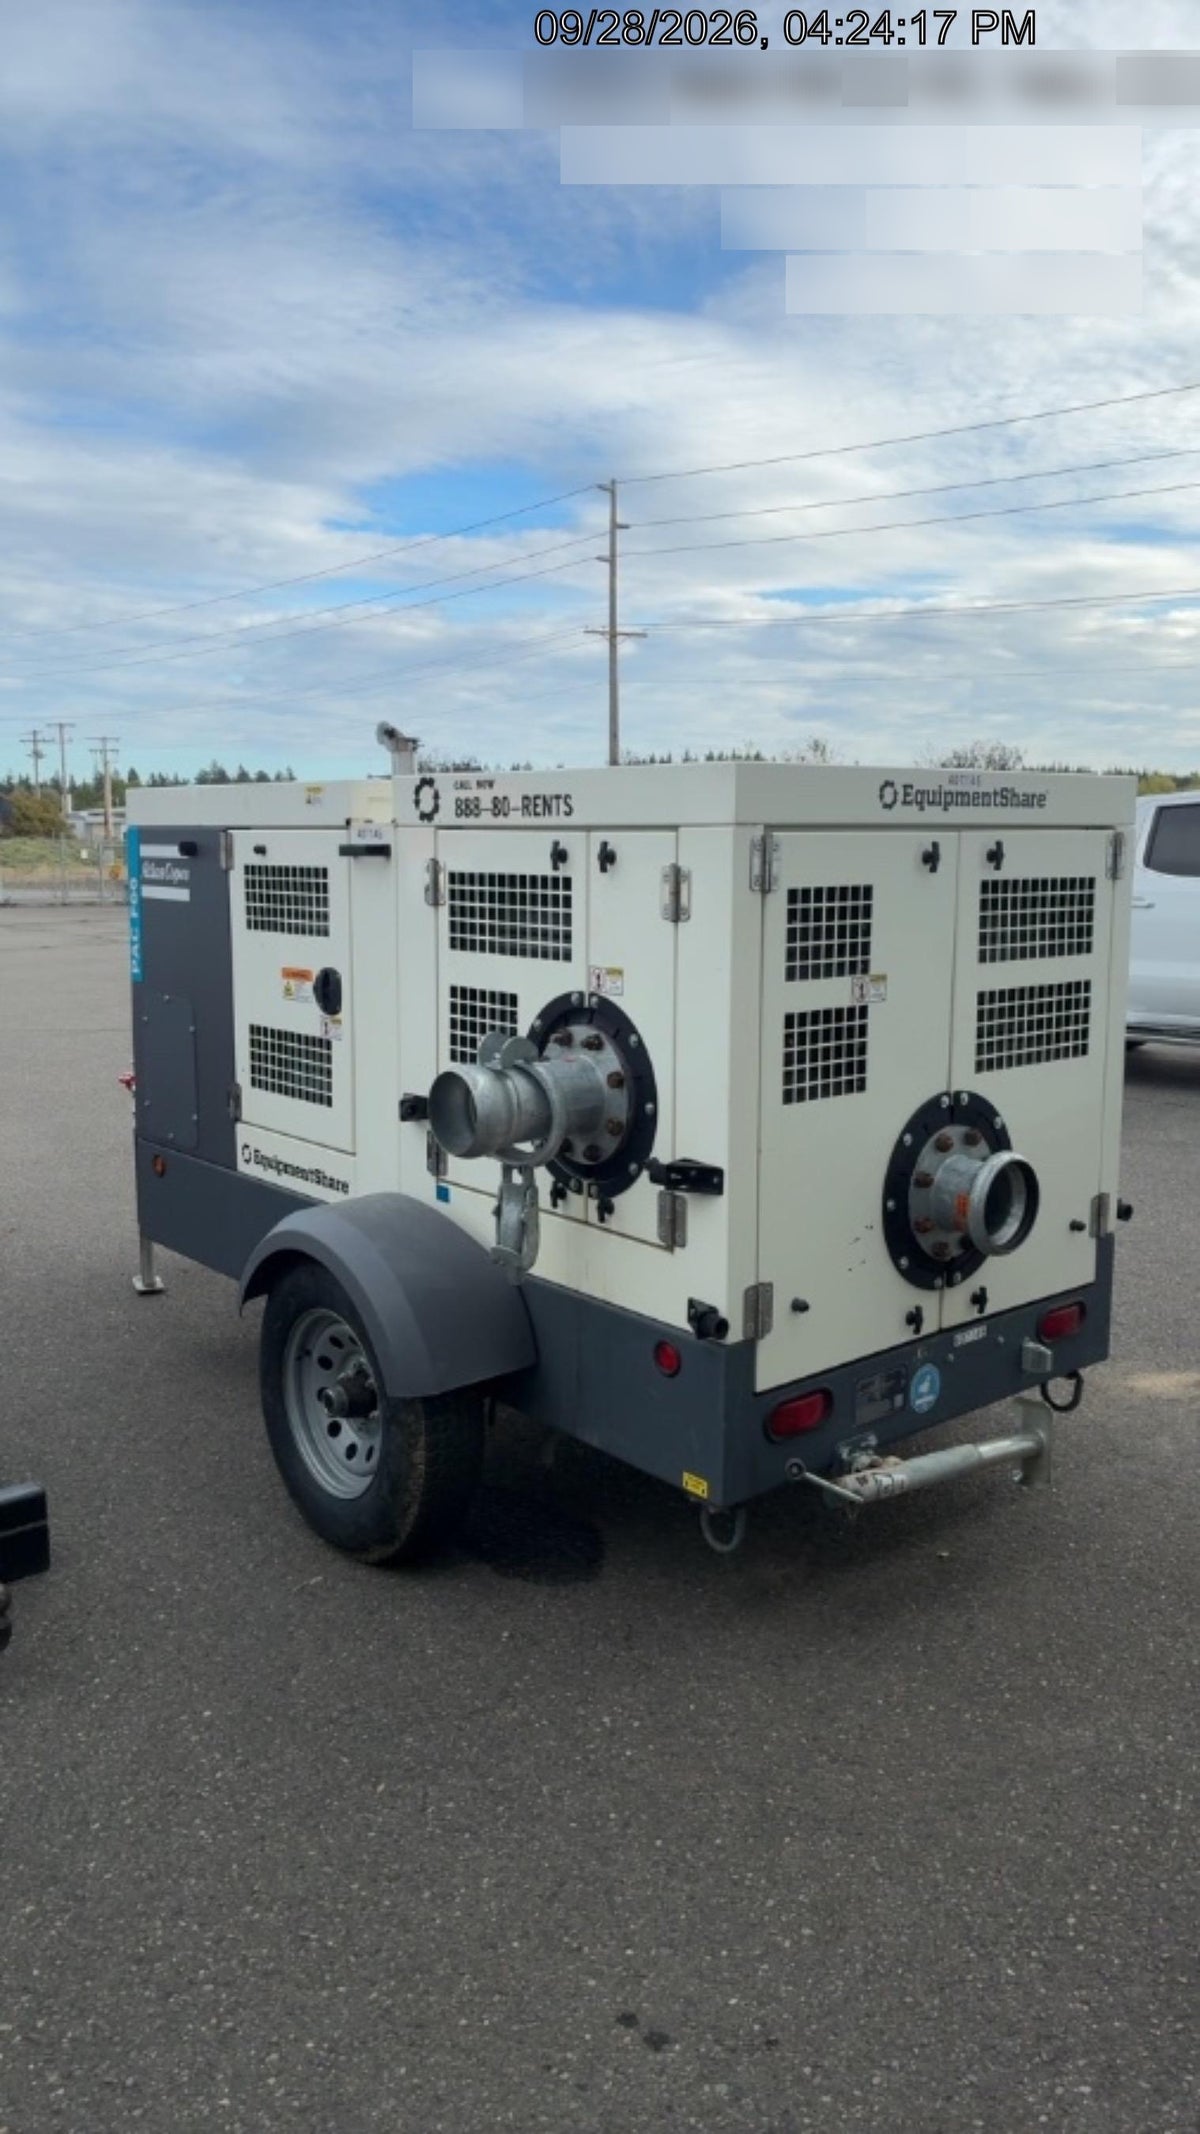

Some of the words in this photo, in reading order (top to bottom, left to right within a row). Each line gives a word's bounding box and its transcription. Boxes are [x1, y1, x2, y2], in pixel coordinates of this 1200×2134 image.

[455, 793, 574, 818] 888-80-RENTS
[901, 784, 1047, 812] EquipmentShare
[254, 1149, 349, 1195] EquipmentShare
